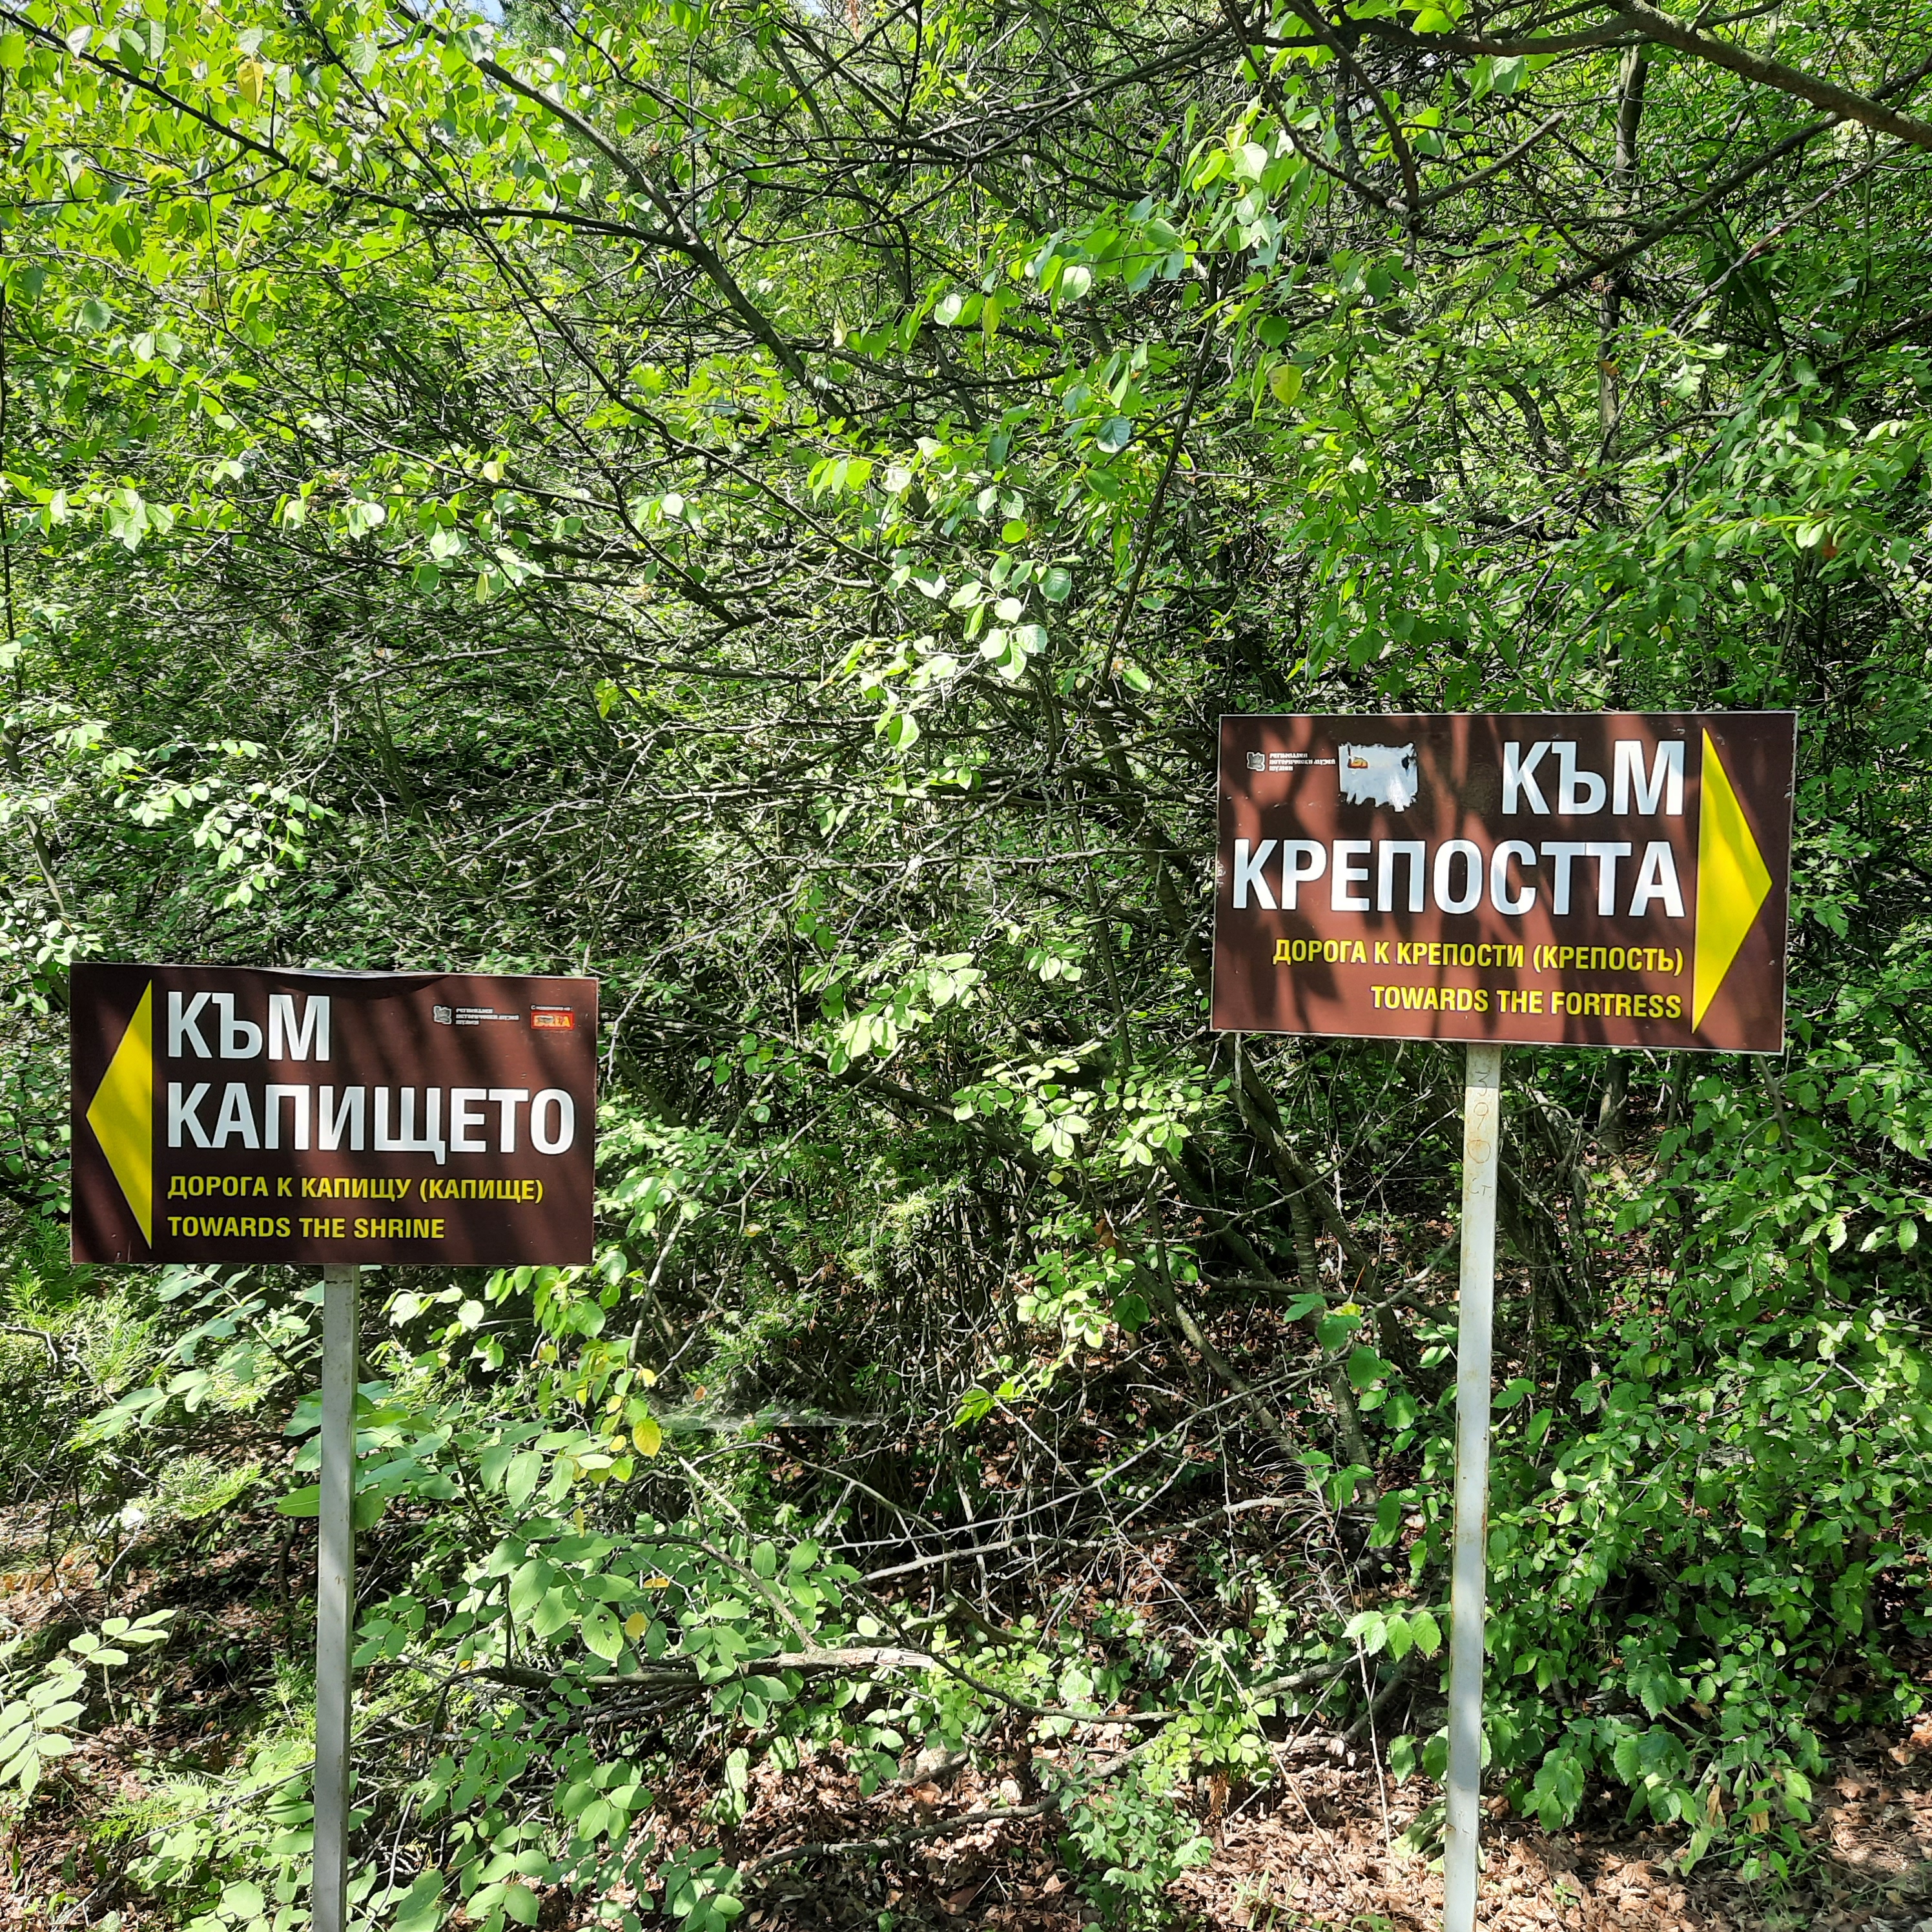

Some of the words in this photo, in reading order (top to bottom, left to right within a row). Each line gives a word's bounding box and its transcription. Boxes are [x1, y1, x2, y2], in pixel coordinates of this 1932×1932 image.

[1501, 740, 1685, 816] КЪМ
[1232, 838, 1686, 918] КРЕПОСТТА
[1272, 938, 1368, 965] ДОРОГА
[1375, 941, 1390, 965] К
[1397, 941, 1525, 968] КРЕПОСТИ
[1533, 944, 1684, 977] (КРЕПОСТЬ)
[167, 991, 331, 1062] КЪМ
[1370, 985, 1489, 1012] TOWARDS
[1497, 989, 1544, 1014] THE
[1551, 991, 1682, 1019] FORTRESS
[167, 1082, 575, 1166] КАПИЩЕТО
[167, 1175, 269, 1199] ДОРОГА
[277, 1177, 293, 1197] К
[301, 1177, 413, 1202] КАПИЩУ
[419, 1178, 544, 1204] (КАПИЩЕ)
[167, 1216, 291, 1238] TOWARDS
[298, 1217, 346, 1238] THE
[353, 1218, 446, 1239] SHRINE
